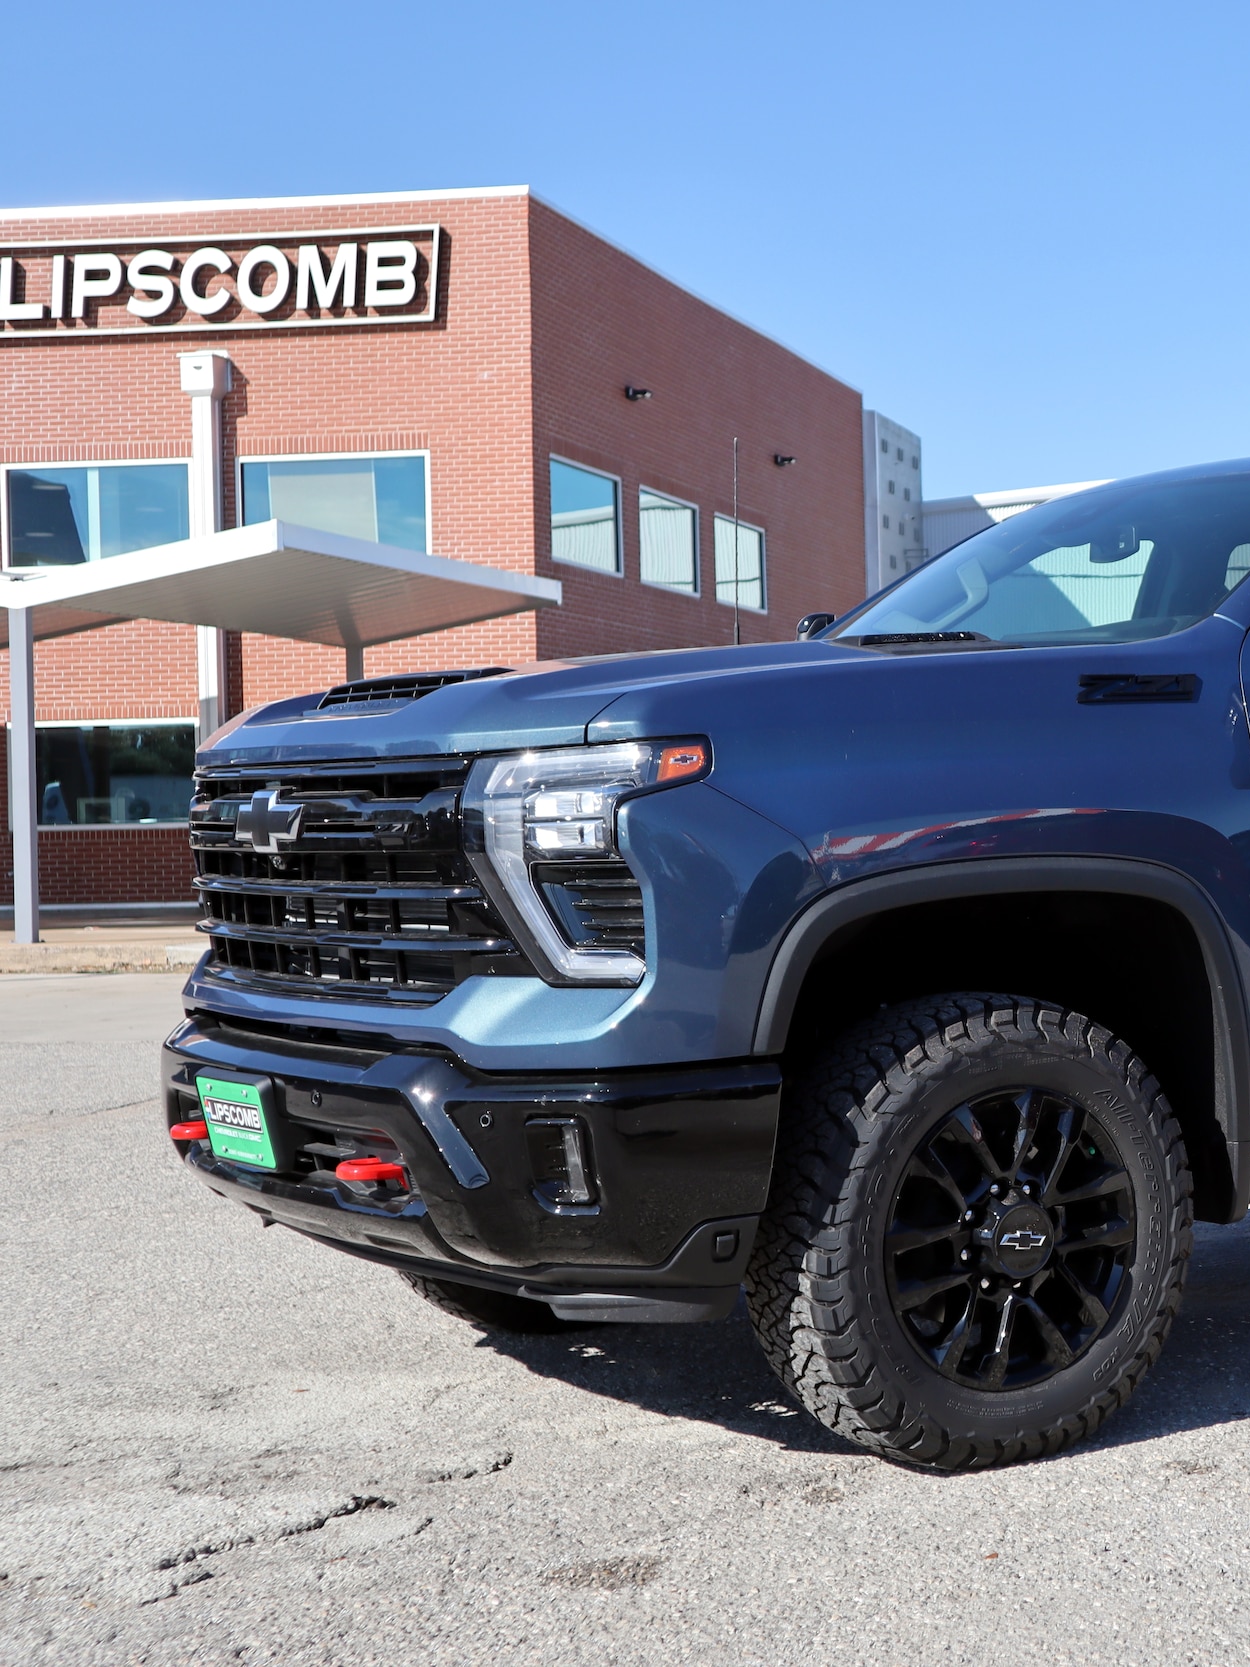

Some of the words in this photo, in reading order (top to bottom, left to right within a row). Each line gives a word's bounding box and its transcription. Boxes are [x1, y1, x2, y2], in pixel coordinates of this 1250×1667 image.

[0, 240, 418, 321] LIPSCOMB
[1077, 673, 1203, 705] Z71
[209, 1101, 260, 1128] LIPSCOMB
